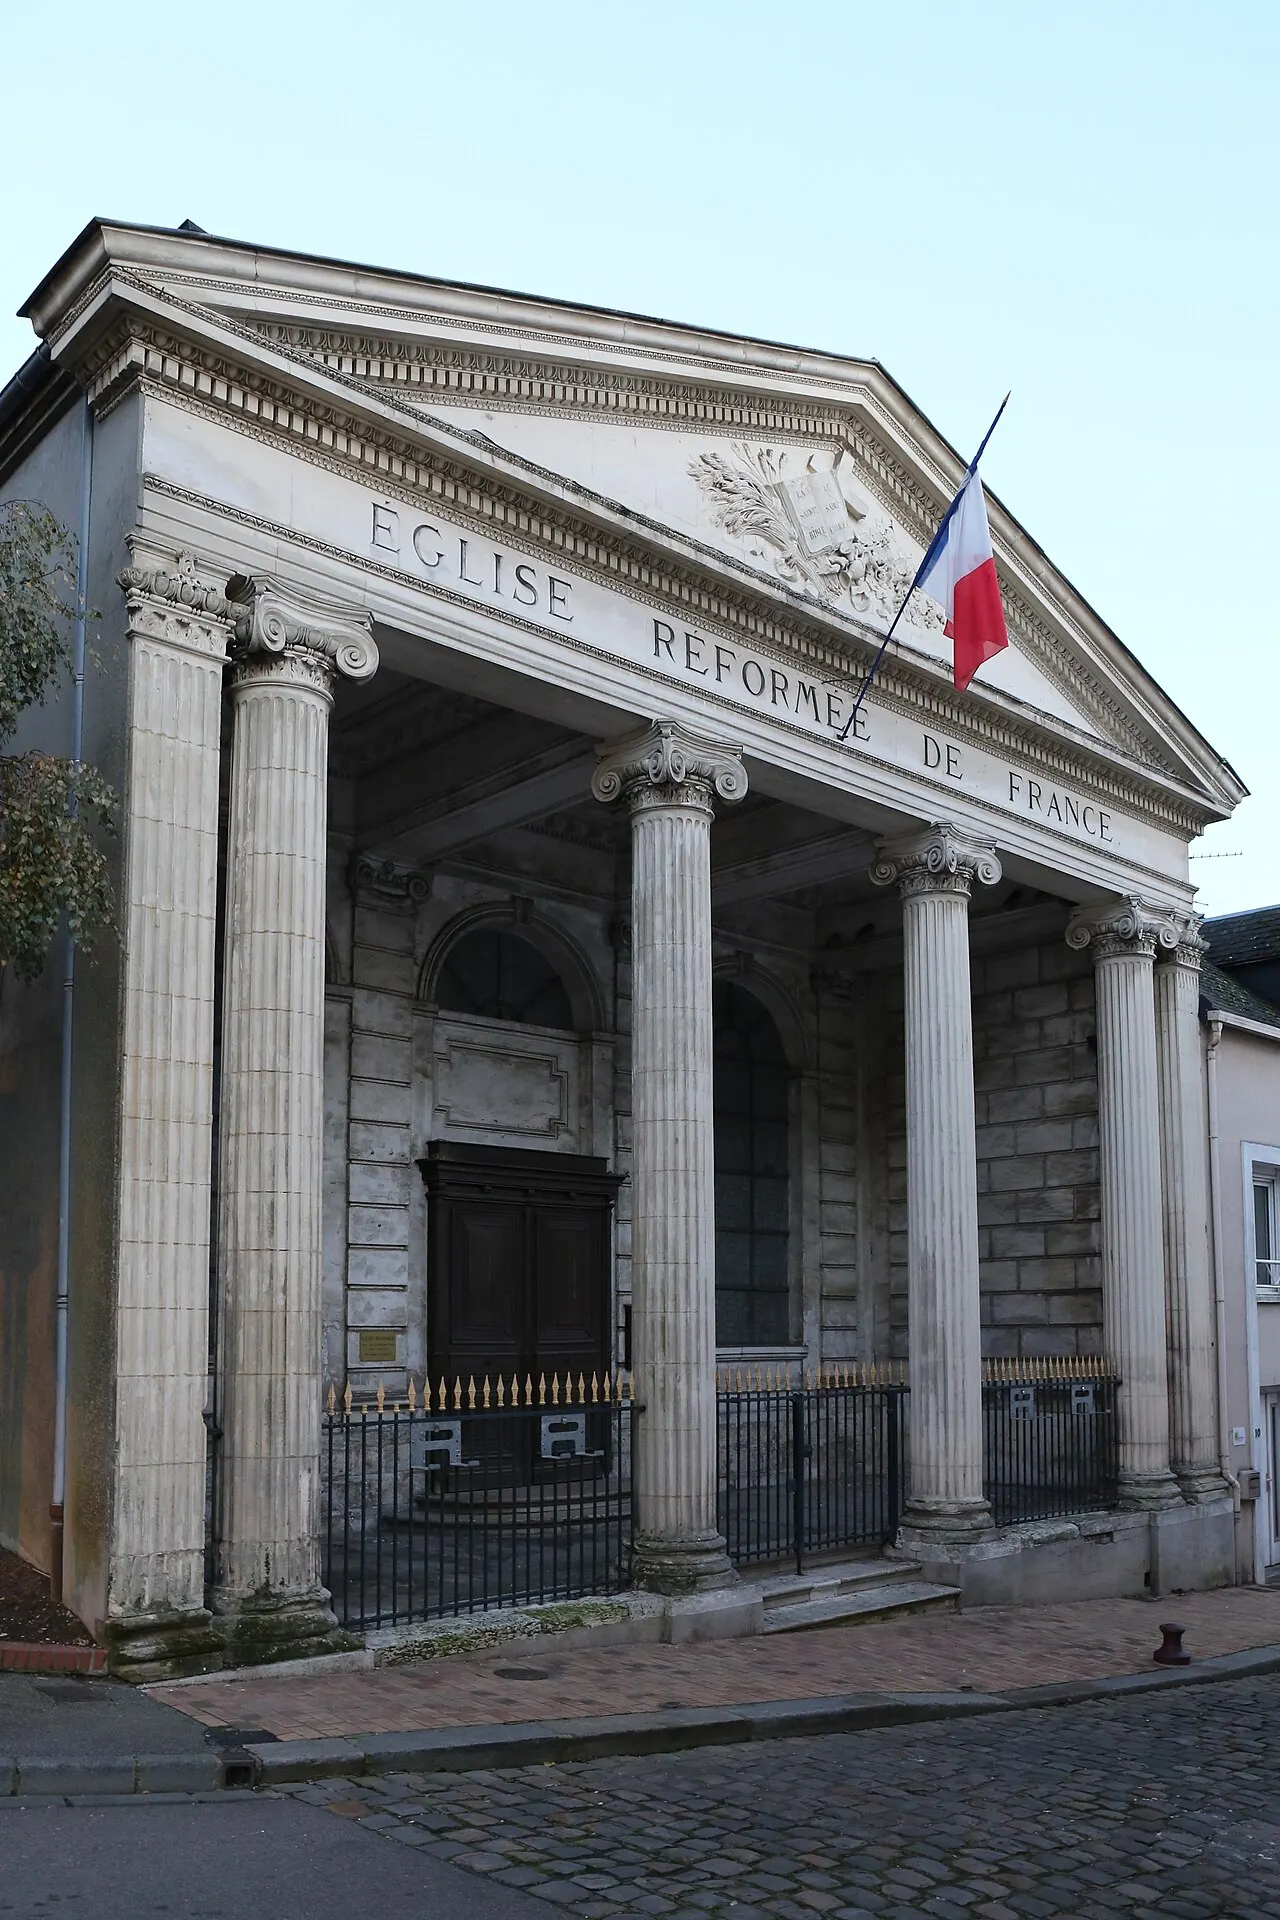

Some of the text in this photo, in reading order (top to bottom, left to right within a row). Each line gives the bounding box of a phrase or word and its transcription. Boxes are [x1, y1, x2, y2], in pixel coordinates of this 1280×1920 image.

[808, 527, 826, 540] BIBLE
[371, 500, 1114, 843] ÉGLISE RÉFORMÉE DE FRANCE
